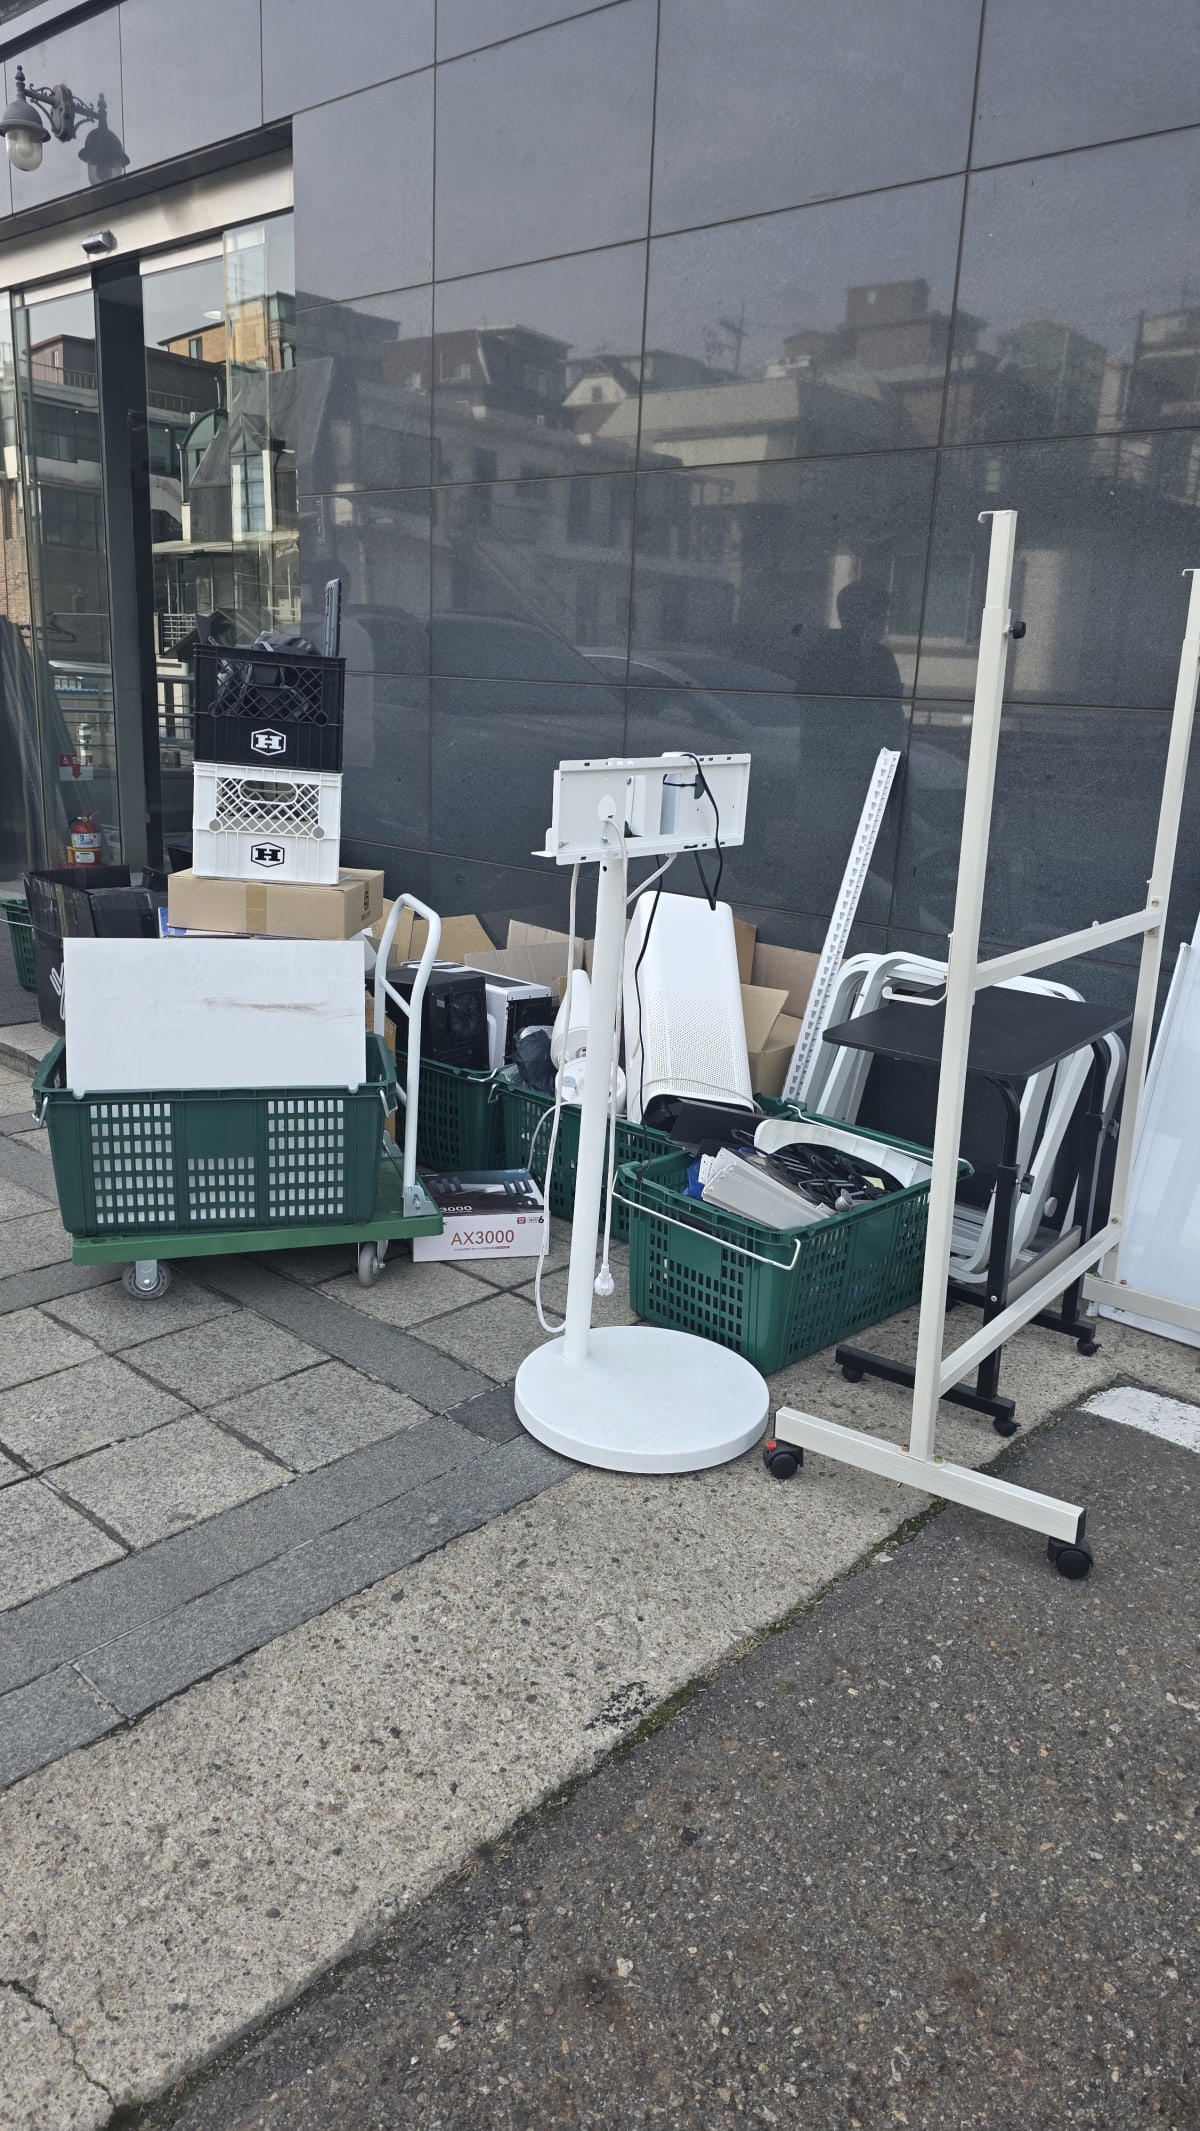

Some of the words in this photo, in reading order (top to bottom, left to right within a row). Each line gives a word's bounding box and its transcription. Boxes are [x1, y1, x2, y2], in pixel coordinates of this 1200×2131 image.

[255, 734, 282, 750] H
[255, 847, 281, 861] H
[450, 1229, 515, 1245] AX3000
